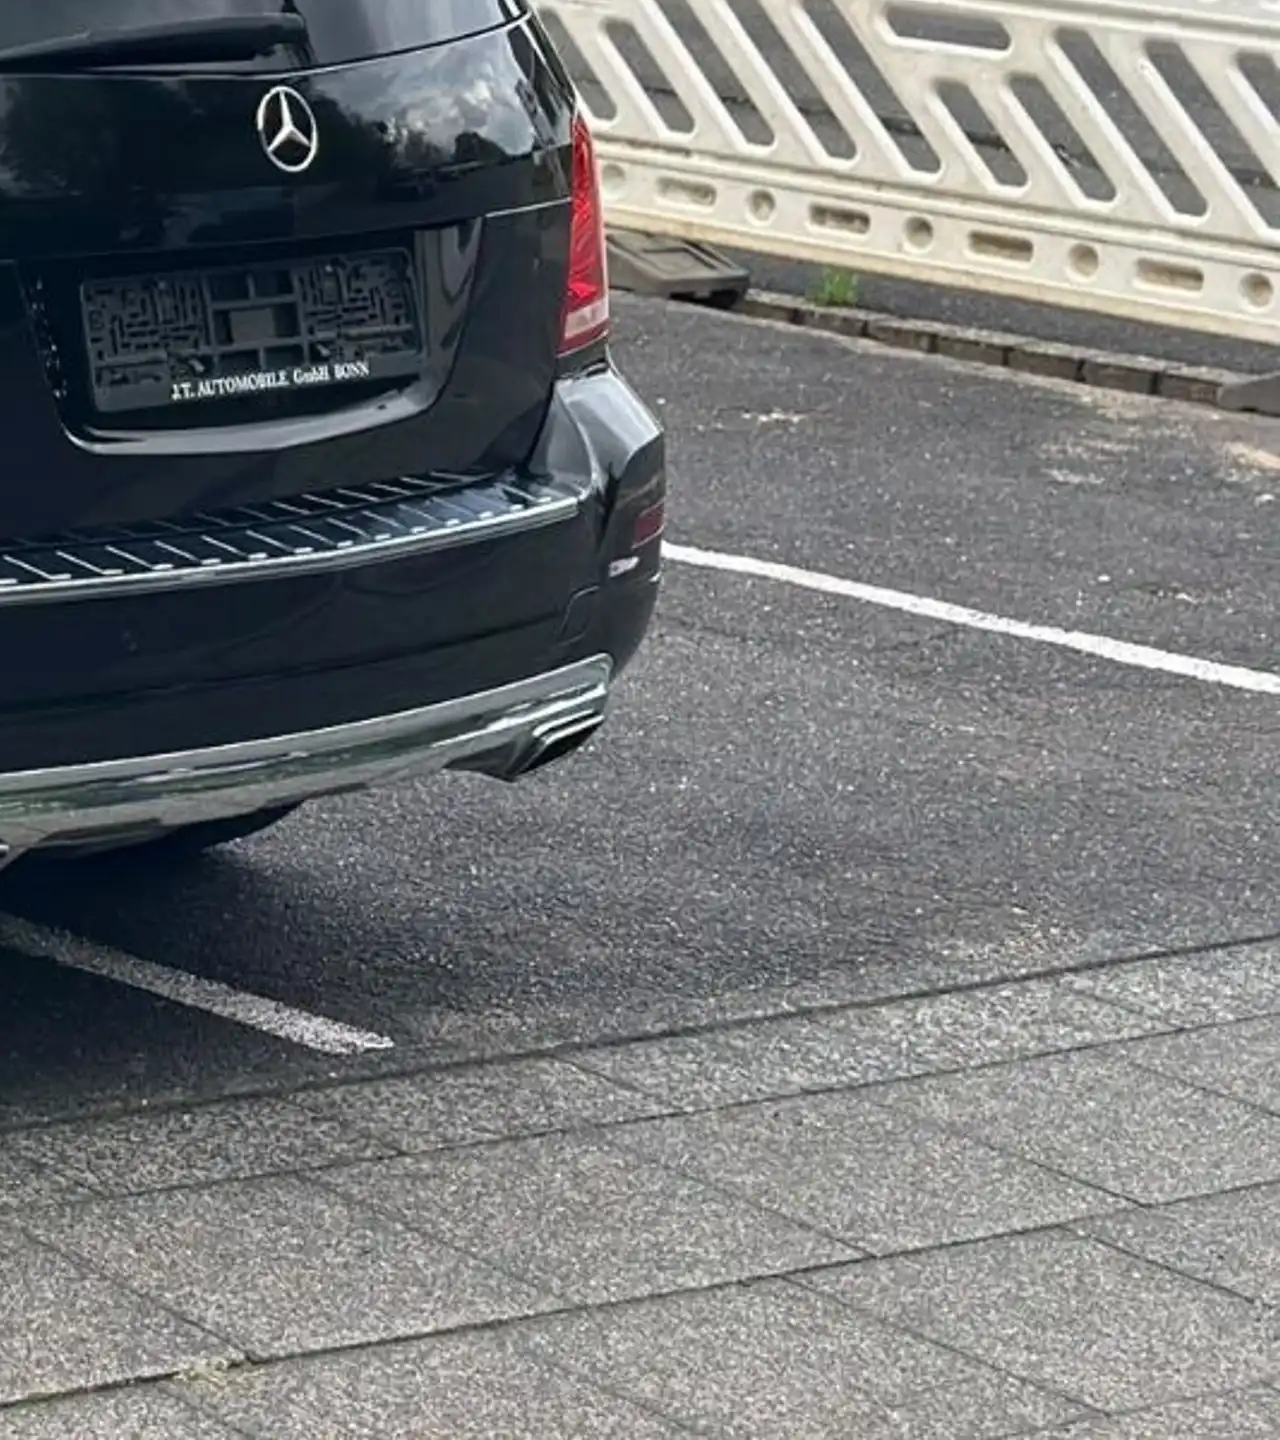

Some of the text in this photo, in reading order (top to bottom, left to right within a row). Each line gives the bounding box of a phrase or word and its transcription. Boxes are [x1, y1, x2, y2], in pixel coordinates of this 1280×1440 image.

[197, 369, 290, 398] AUTOMOBILE
[293, 364, 331, 384] GmbH
[333, 360, 370, 380] BONN
